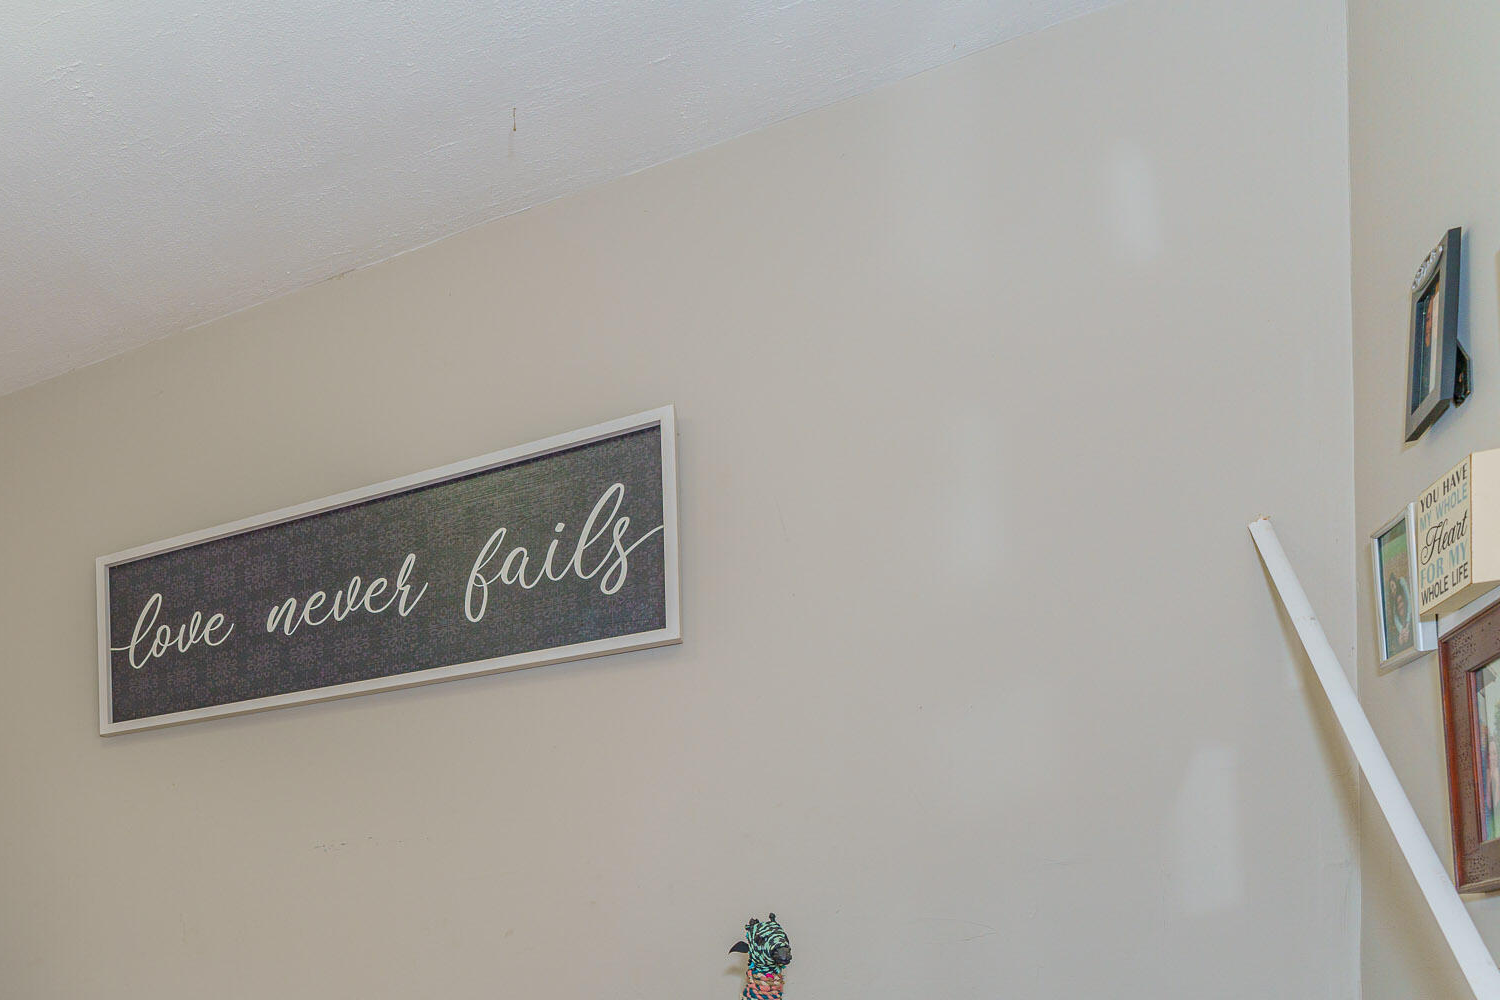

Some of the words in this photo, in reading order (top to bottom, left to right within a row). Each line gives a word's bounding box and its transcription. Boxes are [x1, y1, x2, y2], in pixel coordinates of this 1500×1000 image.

[1419, 510, 1432, 532] MY
[1436, 482, 1468, 520] WHOLE
[1420, 489, 1440, 513] YOU
[1443, 463, 1468, 495] HAVE
[1421, 509, 1469, 566] Heart
[110, 592, 235, 670] love
[266, 553, 429, 637] never
[464, 482, 664, 623] fails
[1420, 557, 1444, 589] FOR
[1449, 538, 1468, 568] MY
[1421, 575, 1449, 606] WHOLE
[1452, 562, 1469, 587] LIFE
